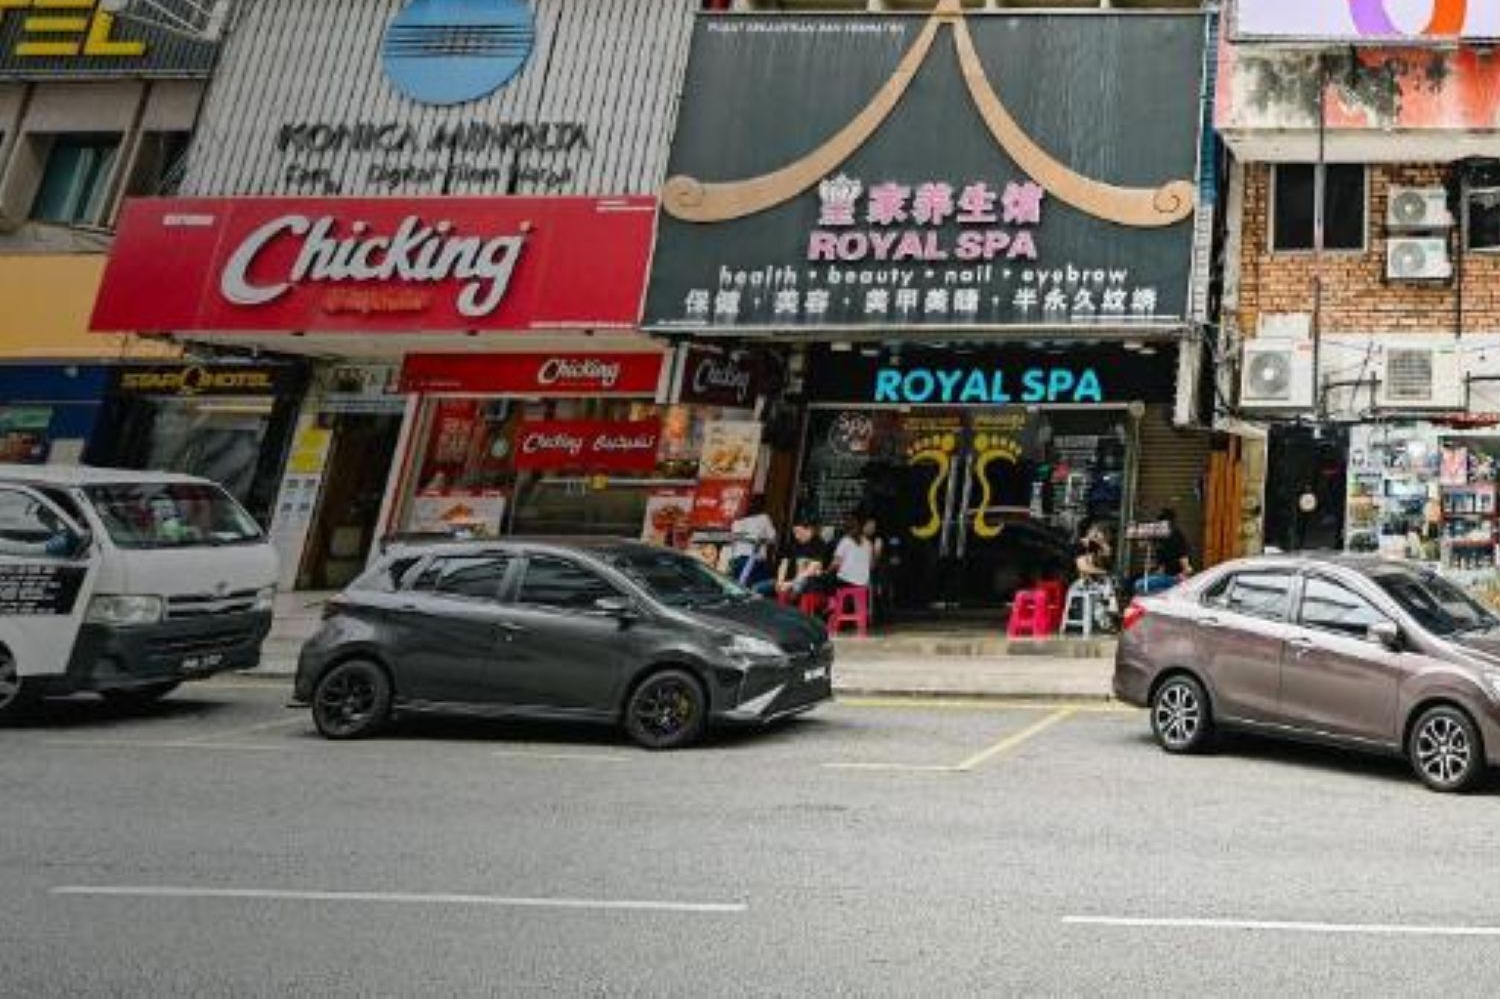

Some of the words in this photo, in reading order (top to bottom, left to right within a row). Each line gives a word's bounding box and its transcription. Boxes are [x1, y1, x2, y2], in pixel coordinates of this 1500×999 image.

[278, 121, 412, 151] KONICA
[428, 121, 589, 151] MINOLTA
[807, 230, 948, 261] ROYAL
[955, 230, 1038, 261] SPA
[219, 214, 530, 317] Chicking
[719, 264, 798, 285] health
[828, 265, 914, 288] beauty
[945, 265, 991, 283] nail
[1021, 262, 1129, 288] eyebrow
[538, 359, 621, 387] Chicking
[874, 367, 1011, 402] ROYAL
[1021, 367, 1102, 402] SPA
